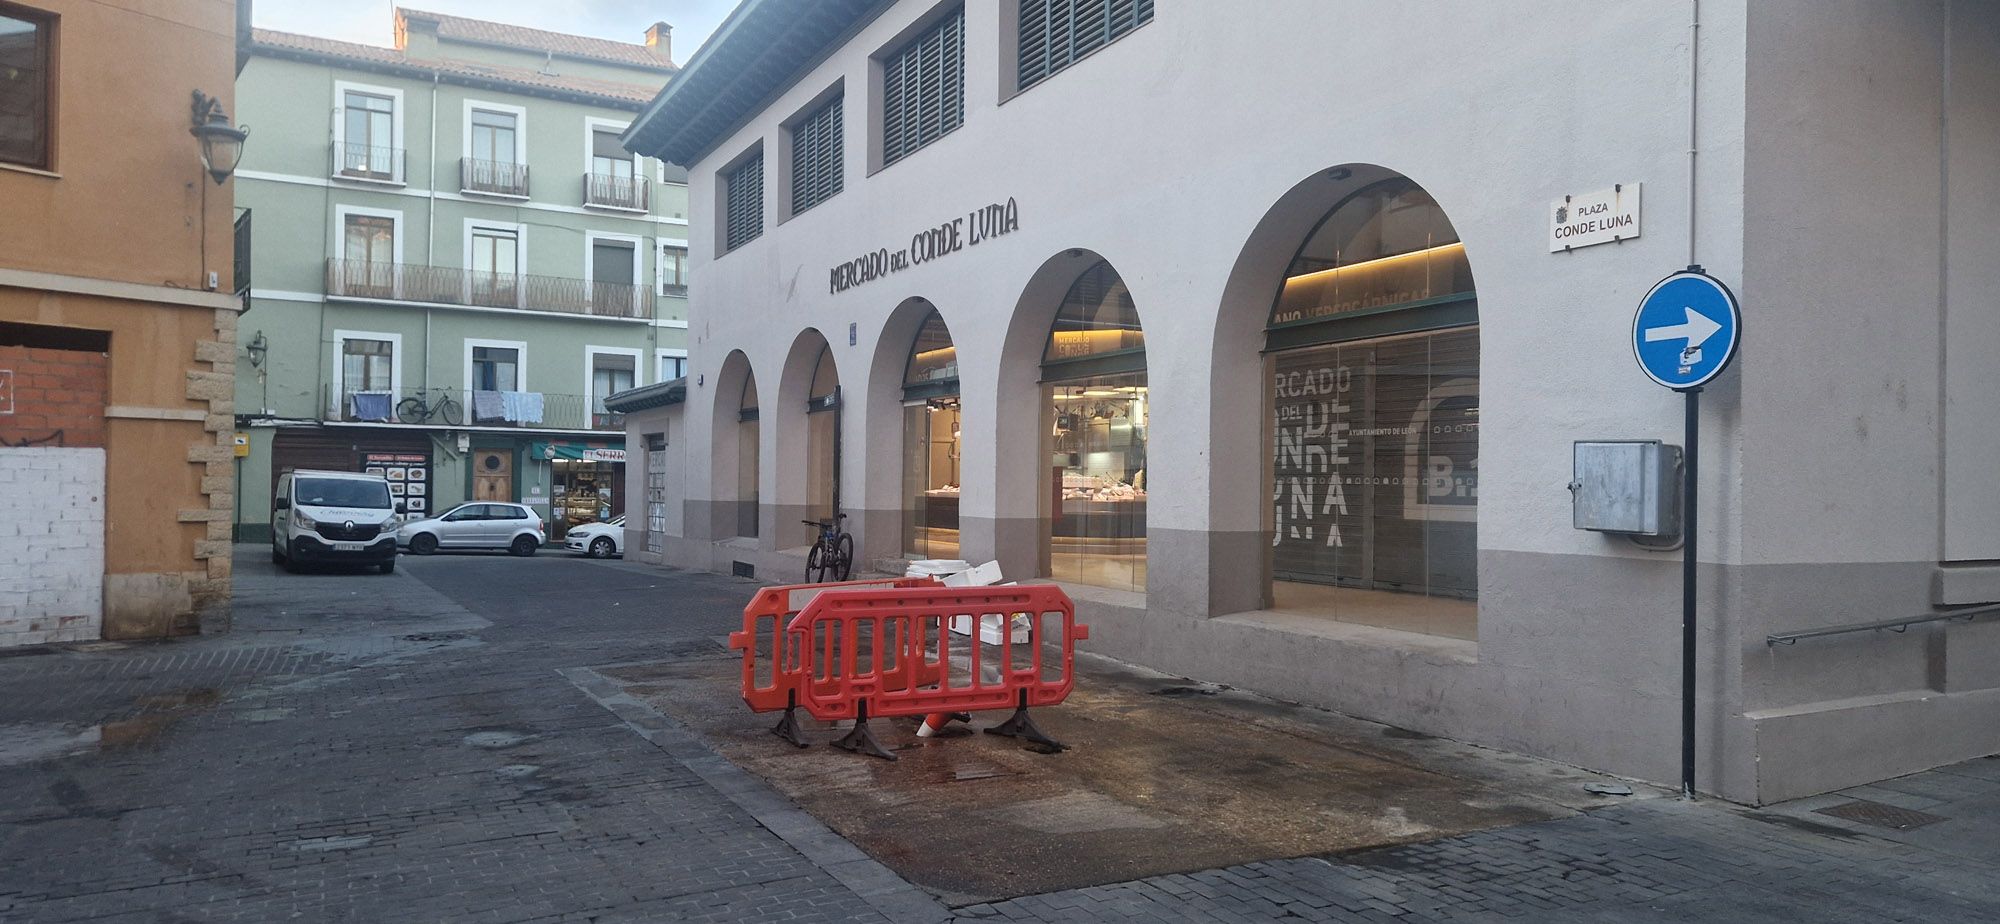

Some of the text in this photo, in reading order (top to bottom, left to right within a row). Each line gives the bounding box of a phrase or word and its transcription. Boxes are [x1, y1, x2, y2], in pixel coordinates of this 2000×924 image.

[1578, 203, 1608, 217] PLAZA
[1555, 214, 1633, 239] CONDE LUNA
[829, 247, 888, 295] MERCADO
[890, 249, 909, 273] DEL
[911, 217, 963, 266] CONDE
[1281, 405, 1302, 420] DEL
[1349, 427, 1391, 436] AYUNTAMIENTO
[1392, 427, 1400, 435] DE
